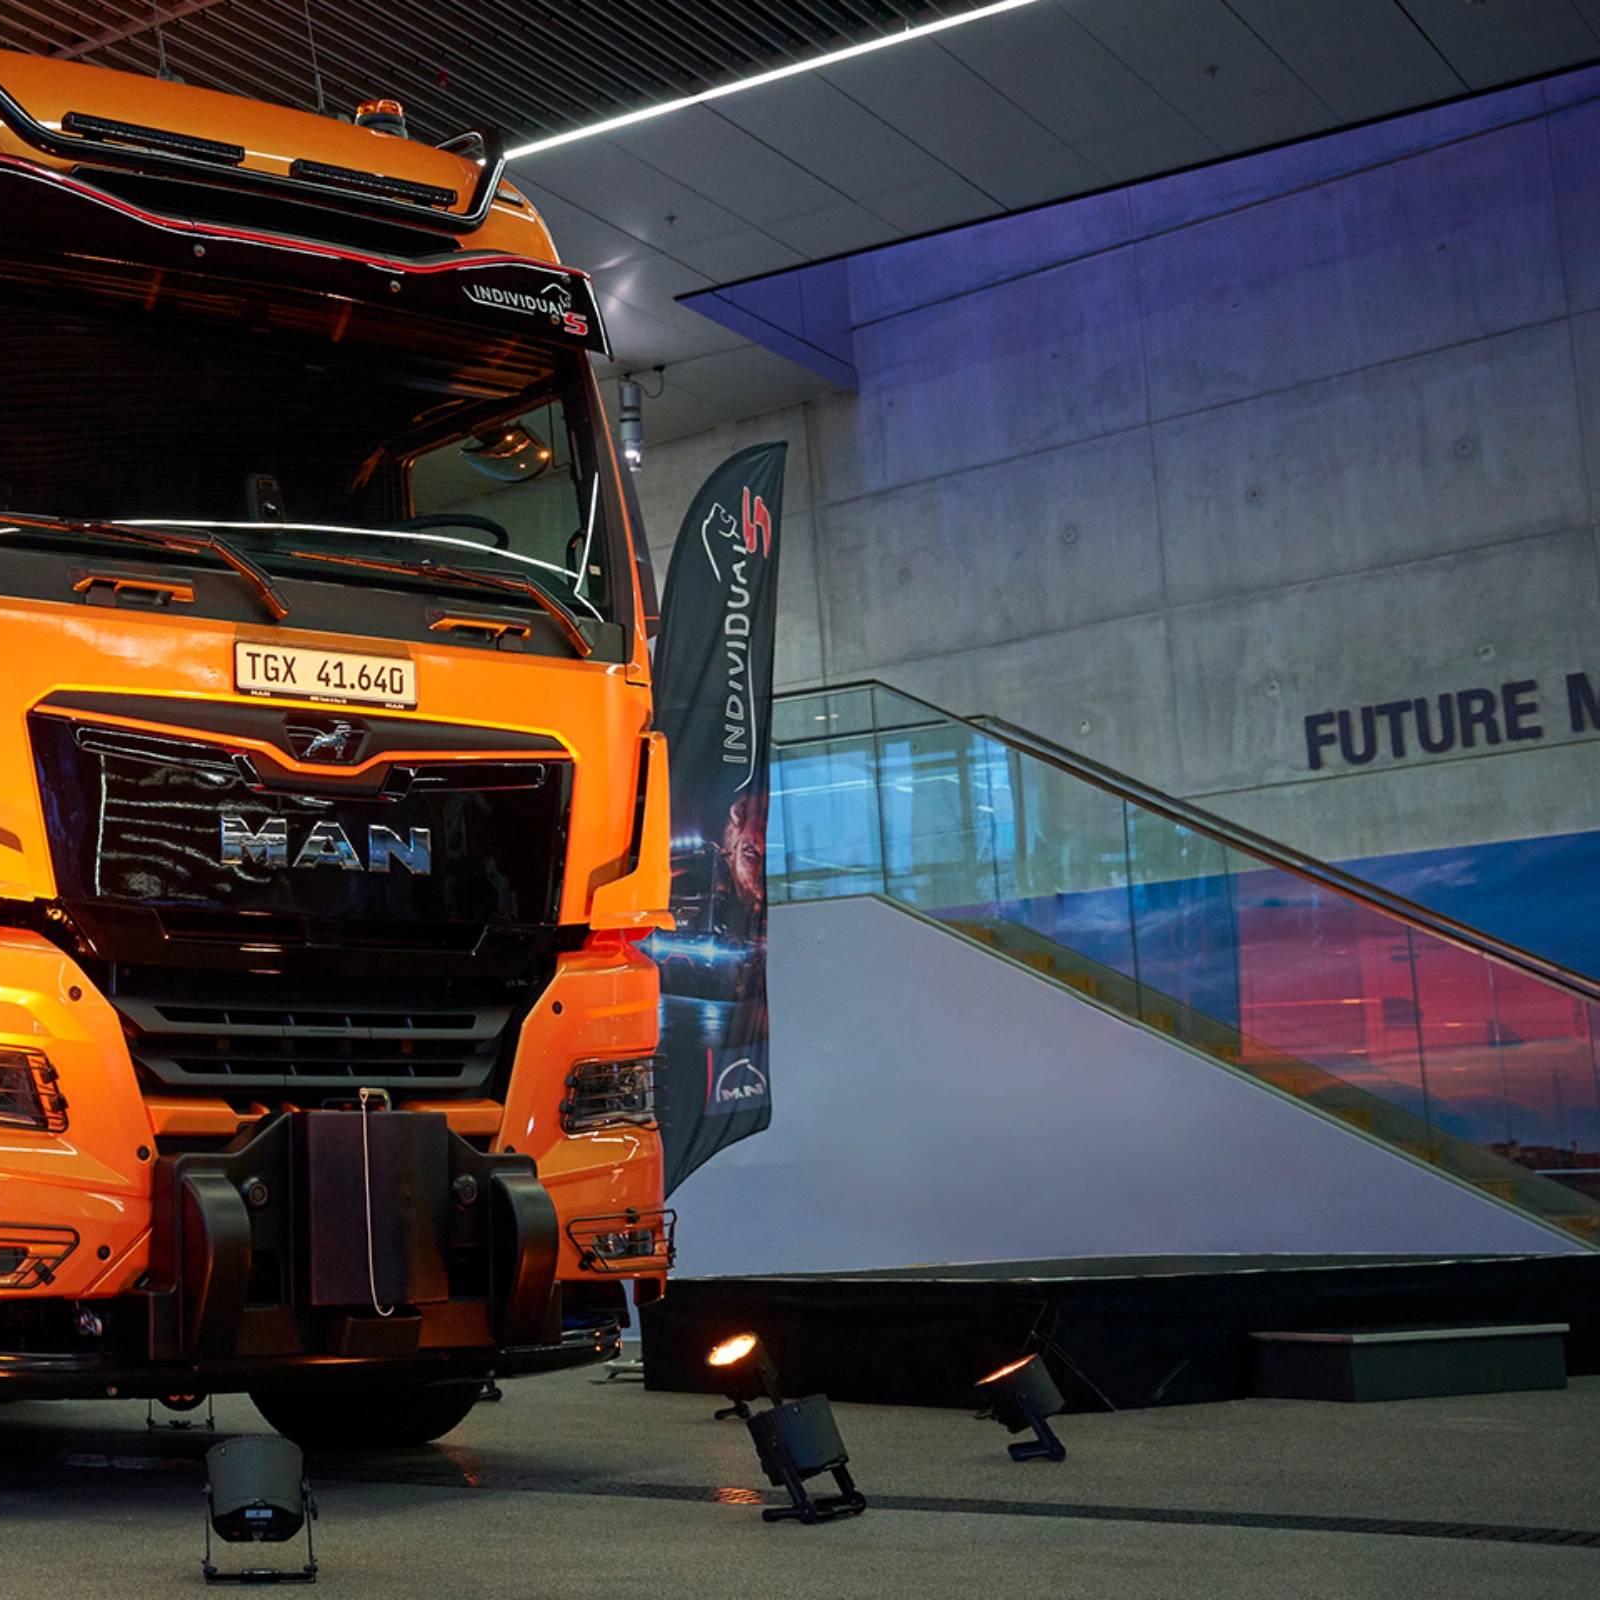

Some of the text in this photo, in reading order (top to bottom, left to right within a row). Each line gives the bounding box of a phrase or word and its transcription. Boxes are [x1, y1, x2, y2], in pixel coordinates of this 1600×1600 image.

[473, 284, 567, 317] INDIVIDUAL
[246, 651, 404, 695] TGX 41.640
[722, 544, 750, 764] INDIVIDUAL
[1304, 679, 1543, 770] FUTURE
[220, 814, 431, 876] MAN
